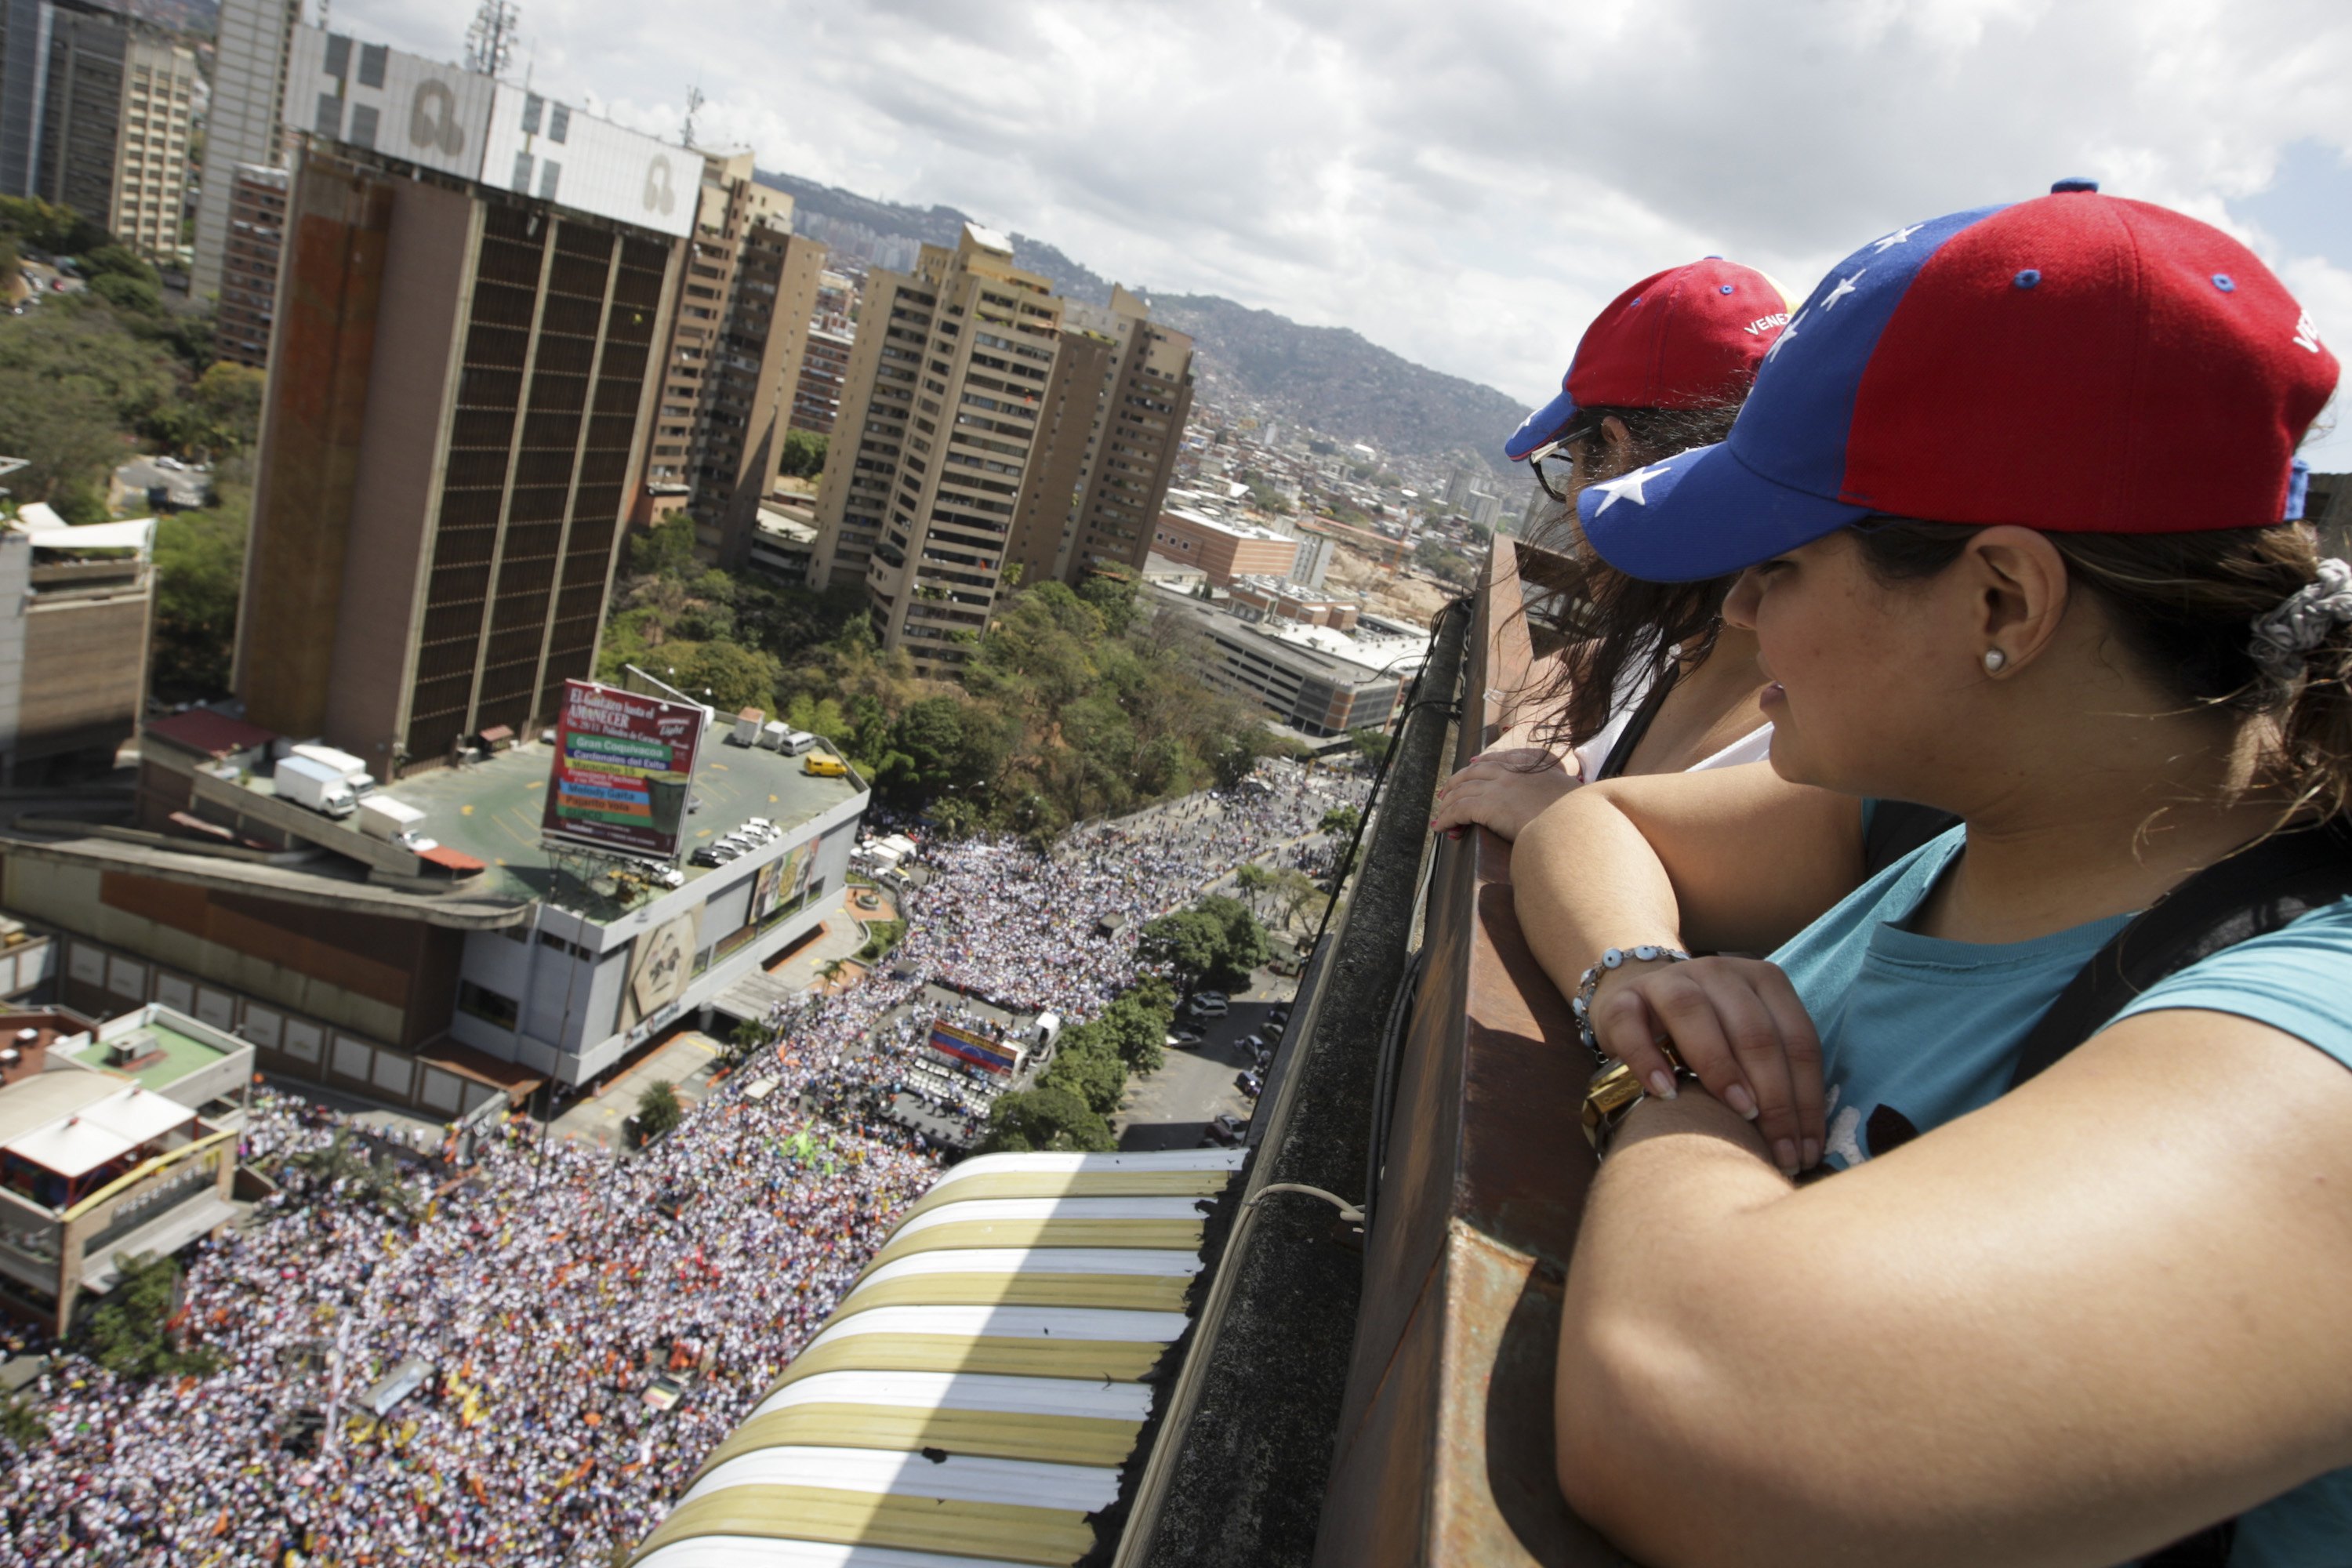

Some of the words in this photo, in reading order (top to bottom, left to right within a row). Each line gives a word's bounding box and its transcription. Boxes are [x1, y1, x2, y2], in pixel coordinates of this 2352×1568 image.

[568, 703, 630, 729] AMANECER
[576, 736, 603, 750] Gran
[604, 739, 665, 758] Coquivacoa
[573, 750, 626, 764] Cardenales
[627, 757, 642, 767] del
[568, 784, 604, 798] Melody
[607, 788, 635, 800] Gaita
